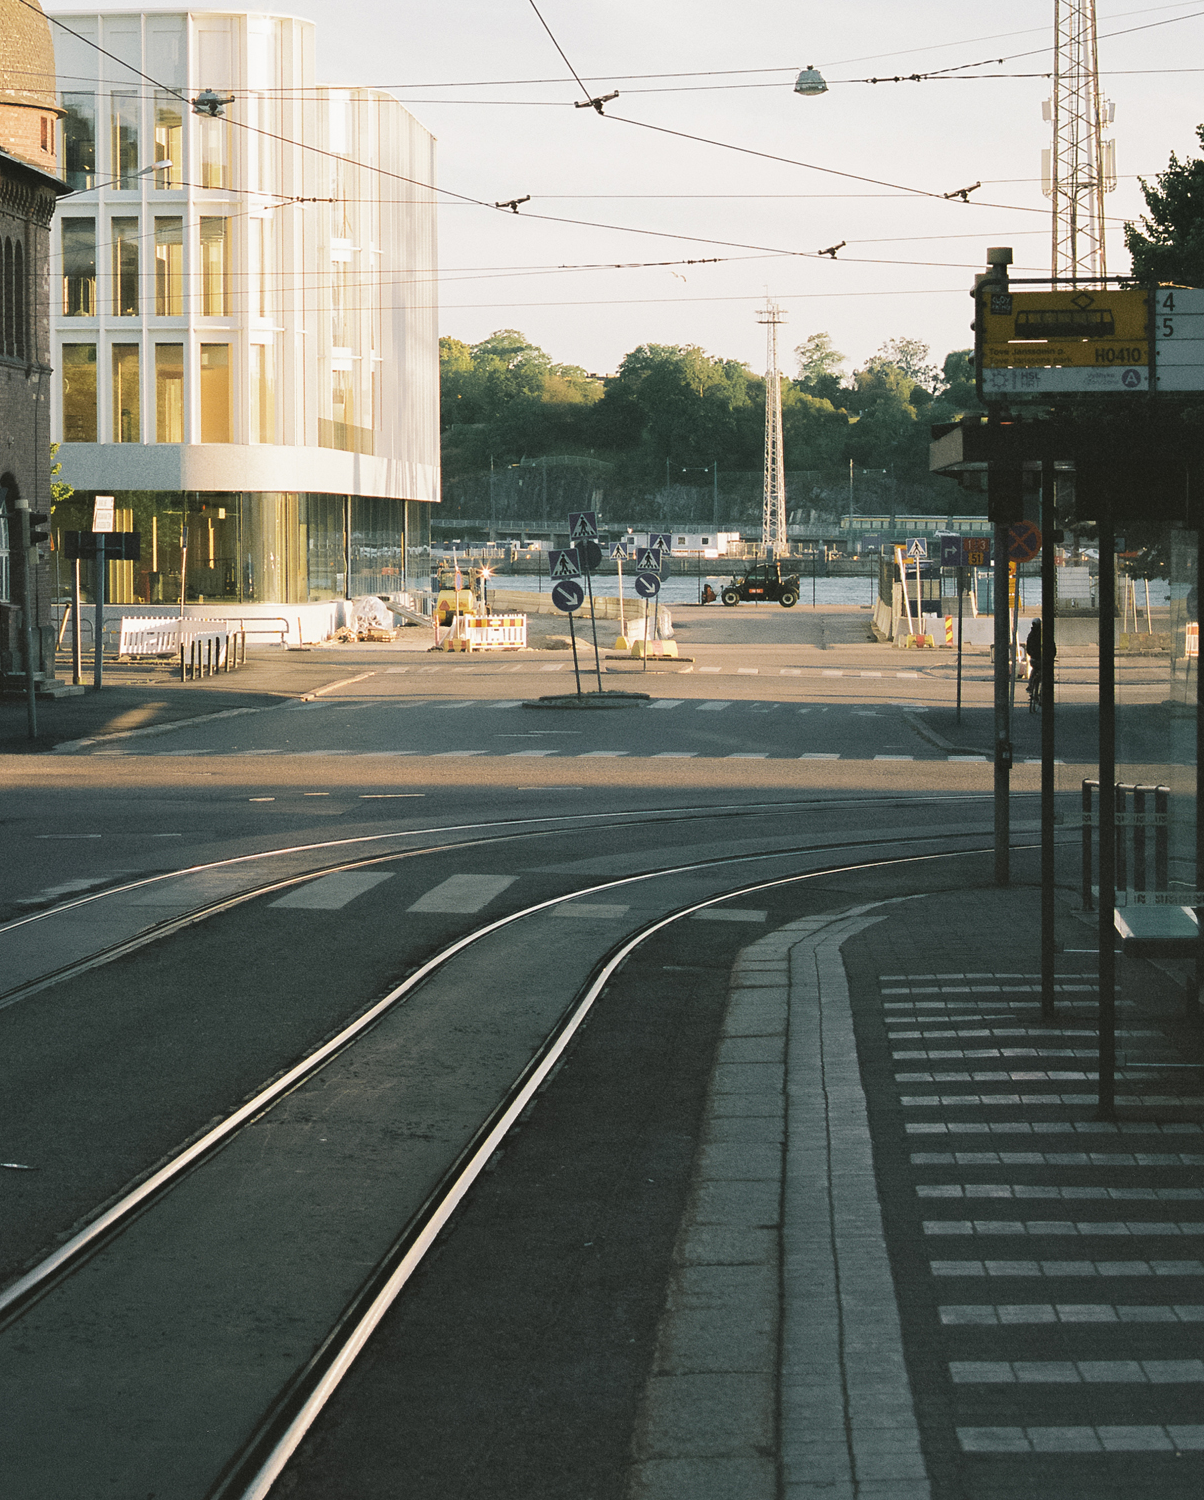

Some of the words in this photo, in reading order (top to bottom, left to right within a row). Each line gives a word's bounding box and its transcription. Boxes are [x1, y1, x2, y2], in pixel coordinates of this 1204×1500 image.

[1162, 292, 1176, 312] 4
[1162, 318, 1174, 337] 5
[989, 347, 1010, 356] Tove
[1021, 371, 1041, 380] HSL
[1124, 371, 1138, 385] A
[1021, 379, 1041, 388] HRT
[971, 553, 981, 563] 51
